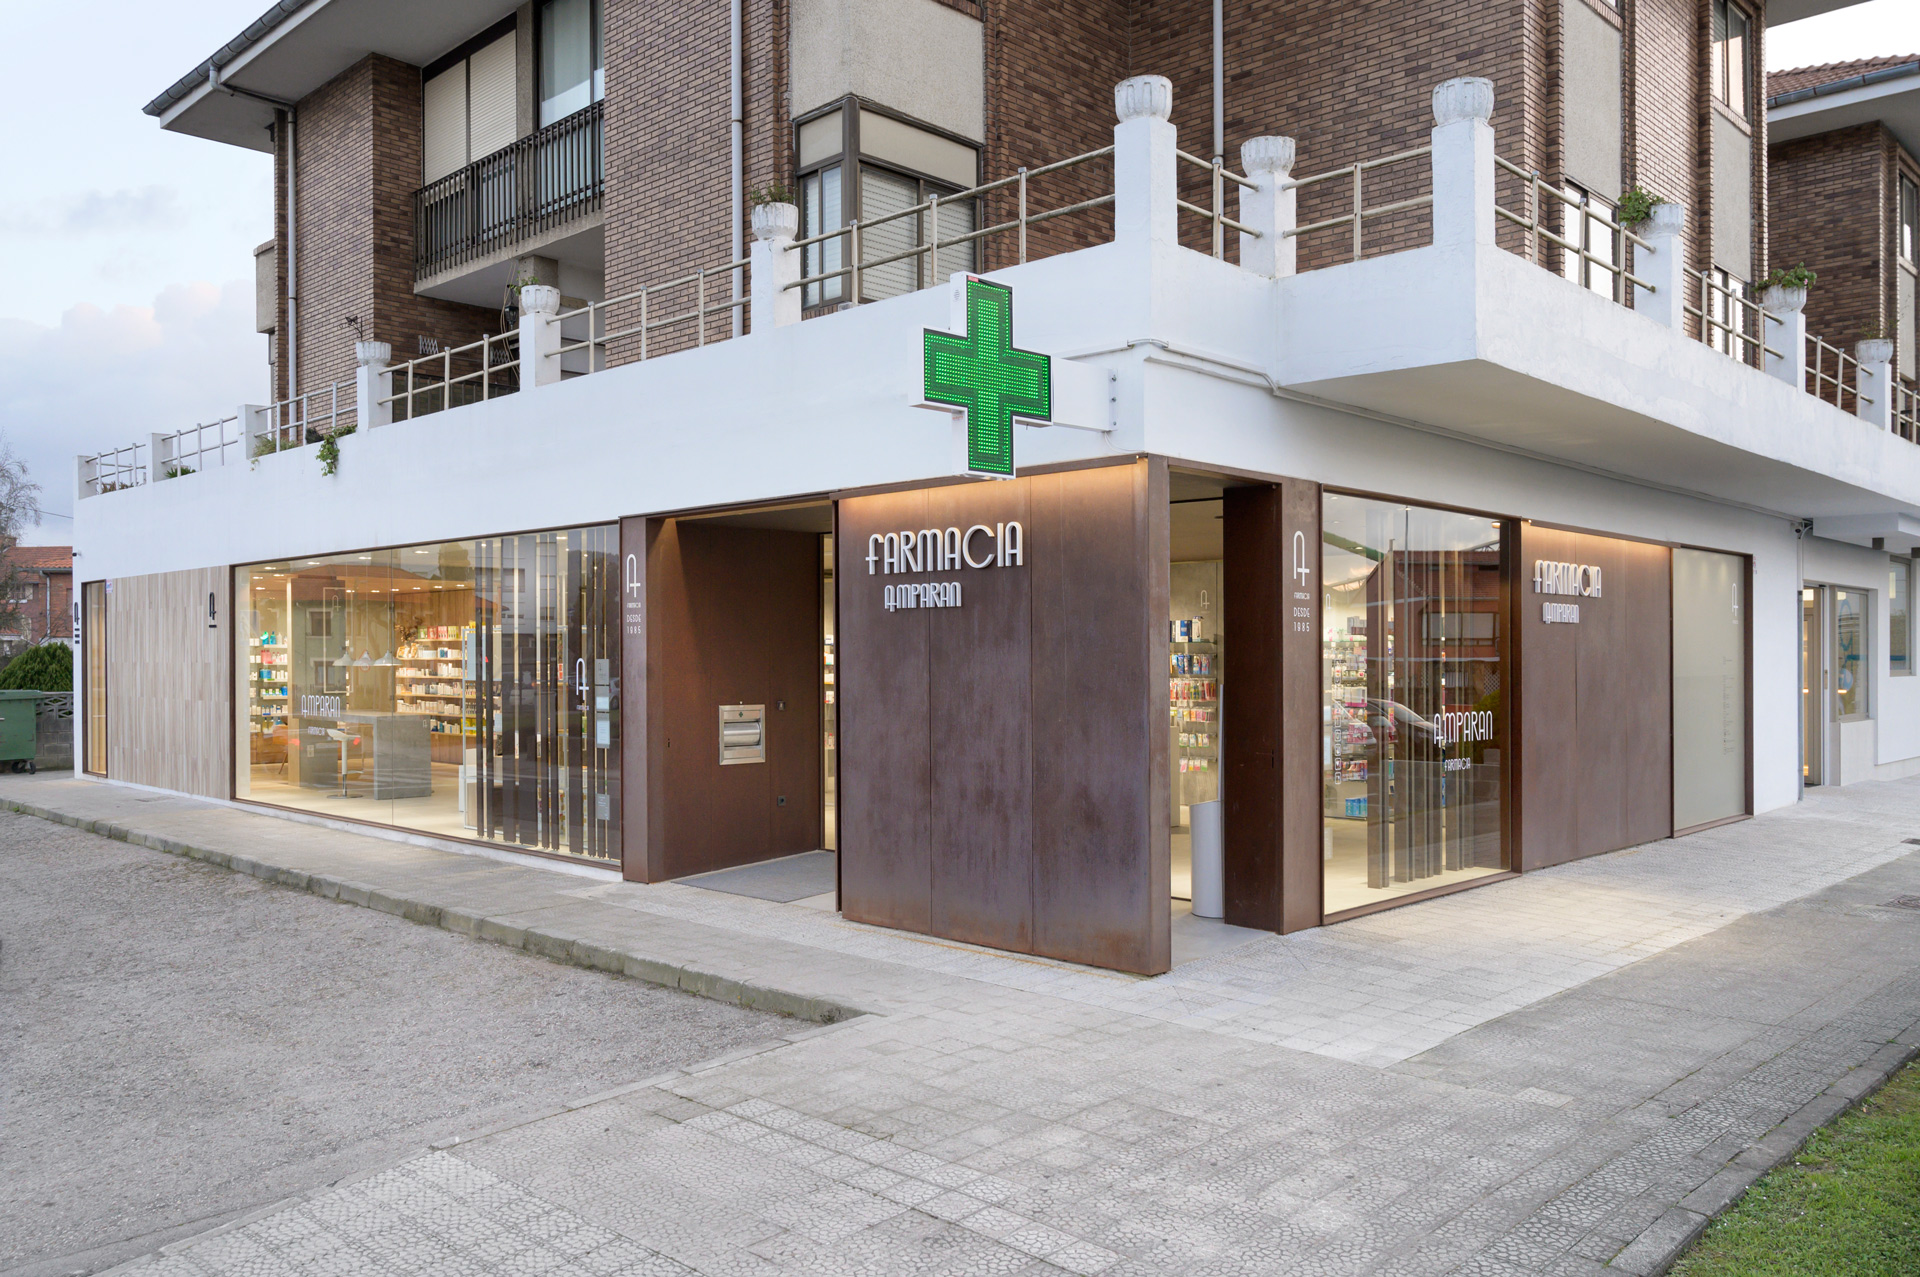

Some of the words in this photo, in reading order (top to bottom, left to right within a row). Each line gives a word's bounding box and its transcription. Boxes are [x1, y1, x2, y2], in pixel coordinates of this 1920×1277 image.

[865, 521, 1023, 575] FARMACIA
[1533, 560, 1601, 597] FARMACIA
[884, 581, 962, 612] AMPARAN
[626, 614, 641, 623] DESDE
[1293, 607, 1310, 618] DESDE
[1542, 602, 1579, 624] AMPARAN
[626, 626, 641, 634] 1985
[1293, 621, 1310, 632] 1985
[301, 694, 341, 718] AMPARAN
[1433, 710, 1493, 749] AMPARAN
[1444, 757, 1471, 772] FARMACIA
